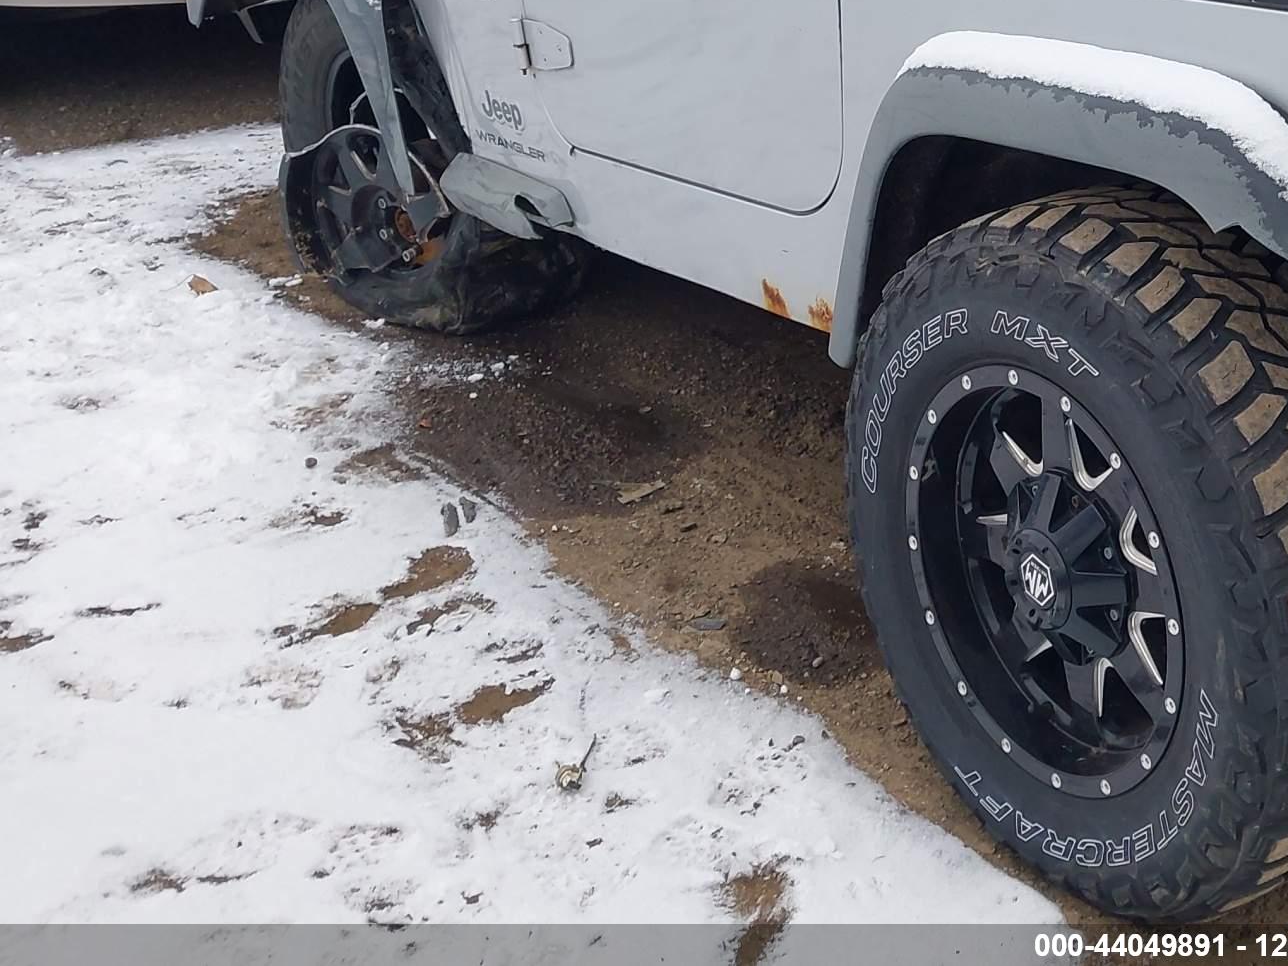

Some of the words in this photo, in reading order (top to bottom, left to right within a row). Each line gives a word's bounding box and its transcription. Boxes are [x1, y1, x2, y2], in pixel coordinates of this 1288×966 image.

[475, 129, 546, 163] WRANGLER
[481, 89, 523, 131] Jeep
[861, 308, 968, 494] COURSER
[990, 310, 1100, 377] MXT
[953, 688, 1219, 867] MASTERCRAFT
